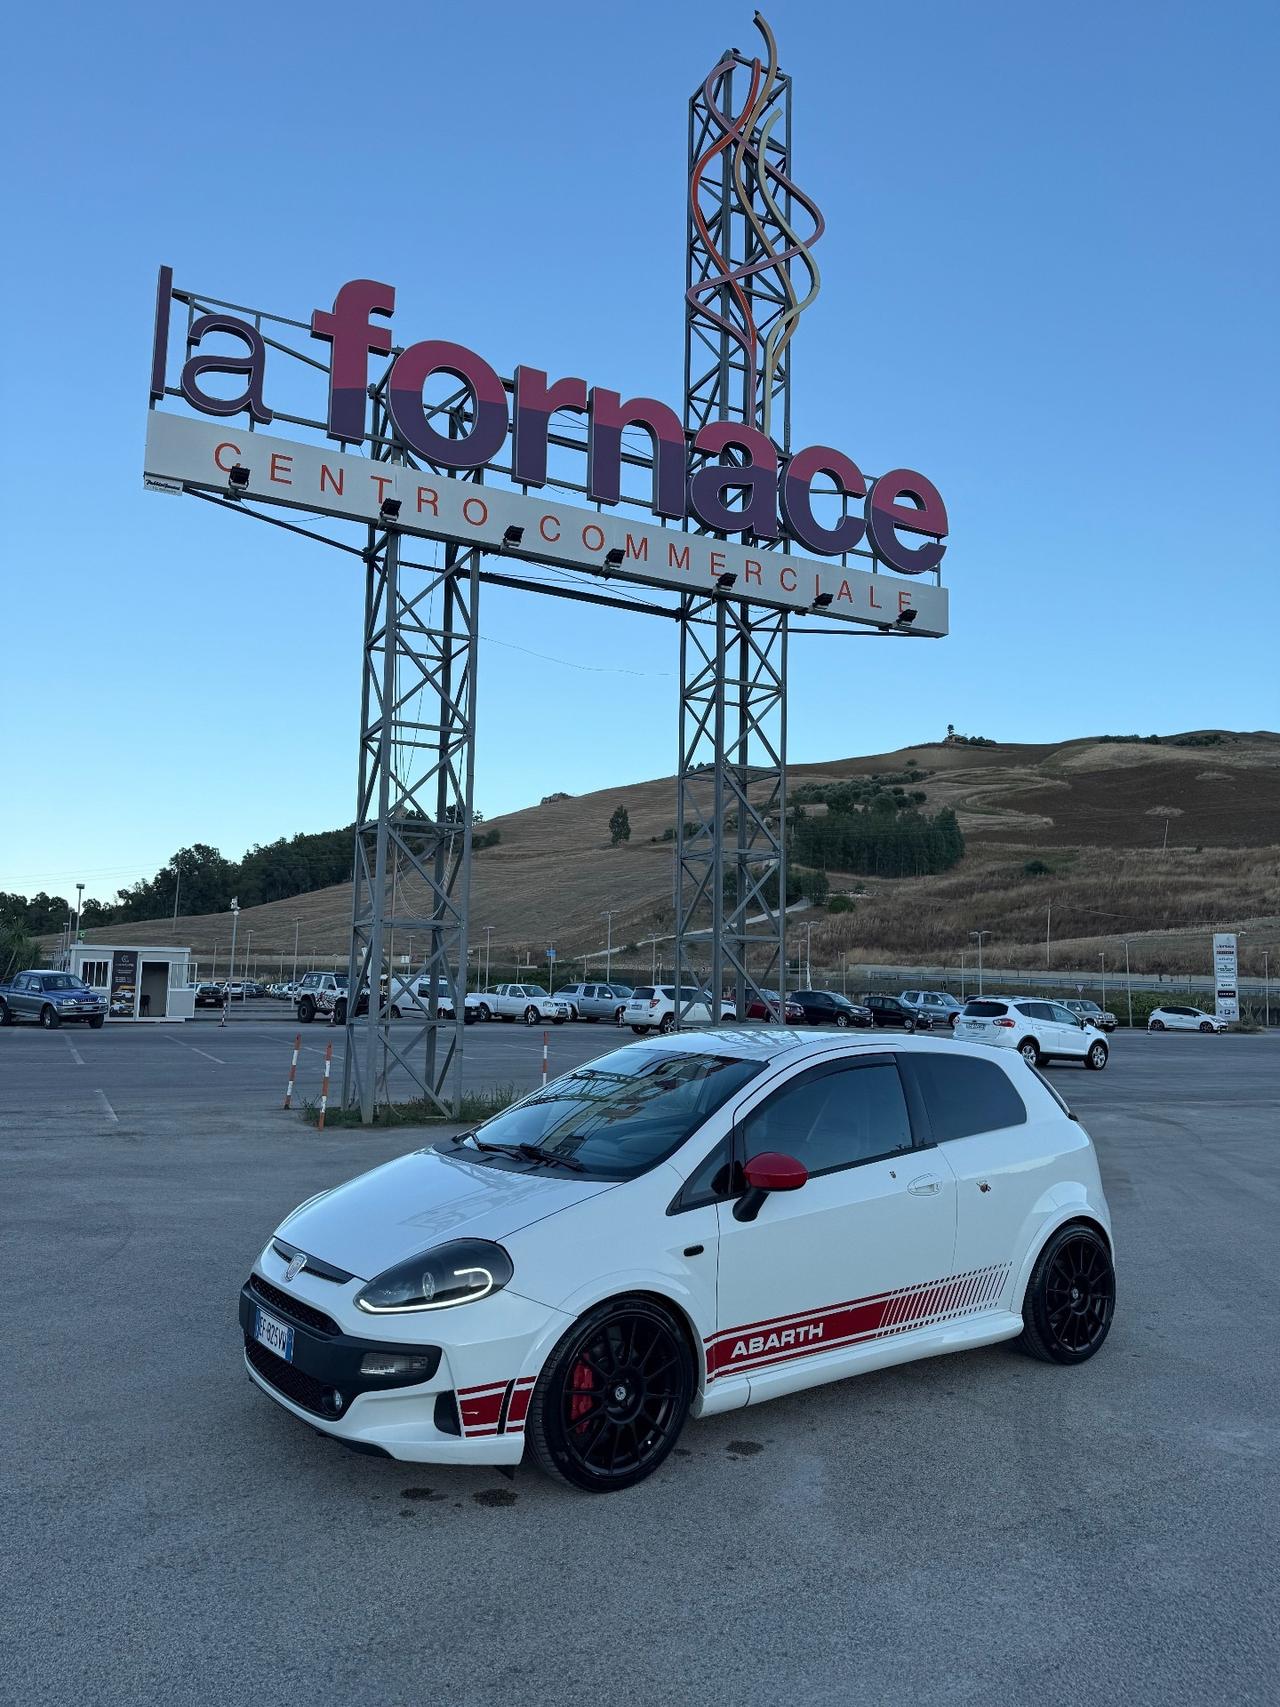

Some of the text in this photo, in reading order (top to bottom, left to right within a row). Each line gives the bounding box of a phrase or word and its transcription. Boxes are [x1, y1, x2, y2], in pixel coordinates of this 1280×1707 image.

[151, 265, 949, 576] la fornace
[214, 442, 912, 614] CENTRO COMMERCIALE
[730, 1322, 824, 1359] ABARTH
